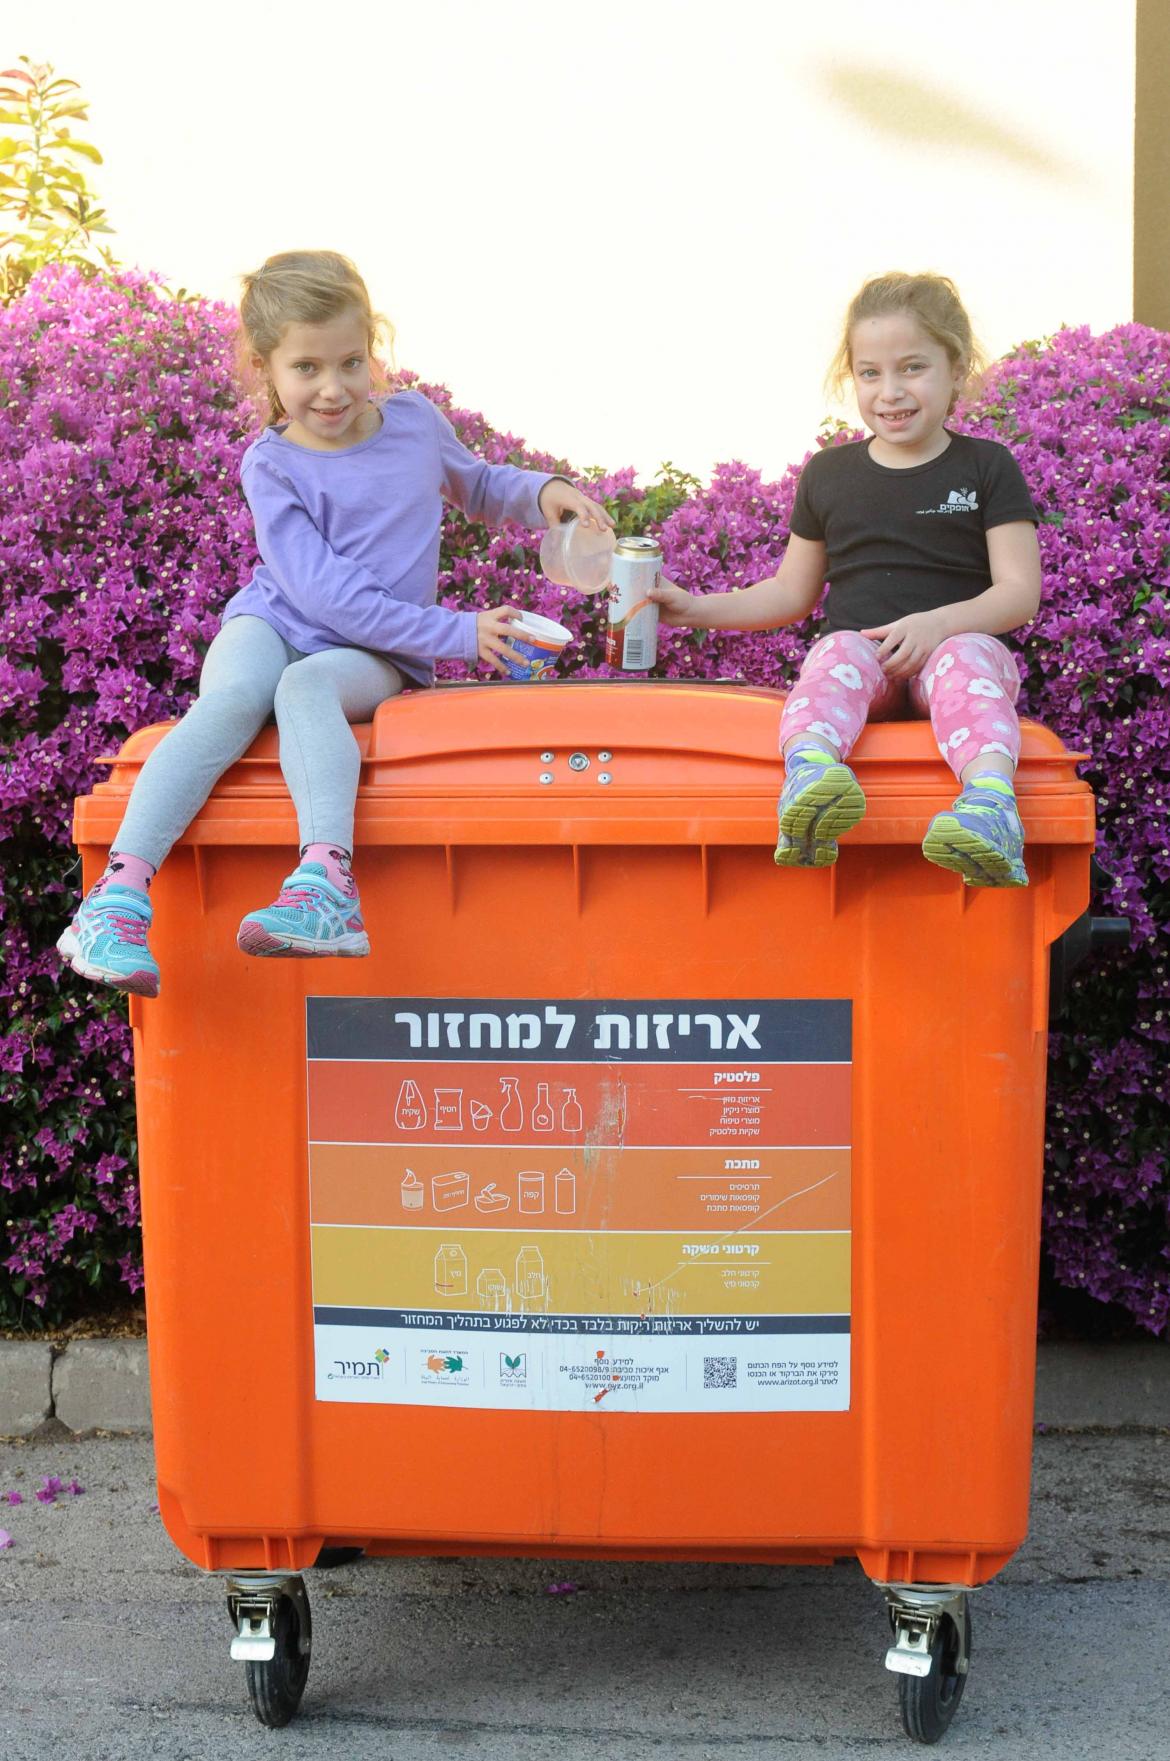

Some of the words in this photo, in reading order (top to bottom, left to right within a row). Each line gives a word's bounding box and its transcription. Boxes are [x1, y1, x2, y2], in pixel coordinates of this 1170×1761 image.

[395, 1006, 576, 1049] למחזור
[594, 1014, 762, 1049] אריזות
[714, 1071, 760, 1085] פלסטיק
[722, 1096, 736, 1104] מזון
[440, 1105, 457, 1114] חטיף
[723, 1107, 739, 1116] ניקיון
[709, 1128, 737, 1136] פלסטיק
[738, 1128, 760, 1136] שקיות
[724, 1159, 760, 1169] מתכת
[729, 1183, 760, 1191] תרסיסים
[523, 1191, 540, 1200] קפה
[730, 1194, 760, 1203] קופסאות
[730, 1204, 760, 1213] קופסאות
[682, 1244, 720, 1257] משקה
[722, 1244, 760, 1256] קרטוני
[738, 1270, 760, 1278] קרטוני
[738, 1280, 760, 1288] קרטוני
[400, 1314, 443, 1326] המחזור
[446, 1314, 491, 1329] בתהליך
[494, 1315, 528, 1329] לפגוע
[531, 1316, 548, 1330] לא
[581, 1317, 614, 1331] בלבד
[551, 1319, 578, 1331] בכדי
[617, 1320, 650, 1334] ריקות
[655, 1320, 692, 1331] אריזות
[695, 1318, 742, 1334] להשליך
[745, 1320, 760, 1331] יש
[594, 1358, 609, 1366] נוסף
[612, 1358, 634, 1366] למידע
[788, 1361, 798, 1369] על
[800, 1361, 816, 1370] נוסף
[817, 1361, 838, 1369] למידע
[334, 1361, 380, 1376] תמיר
[656, 1367, 669, 1375] אגף
[569, 1373, 611, 1381] 04-6520100
[780, 1370, 804, 1378] הברקוד
[643, 1375, 660, 1383] מוקד
[757, 1378, 819, 1387] www.arizot.org.il
